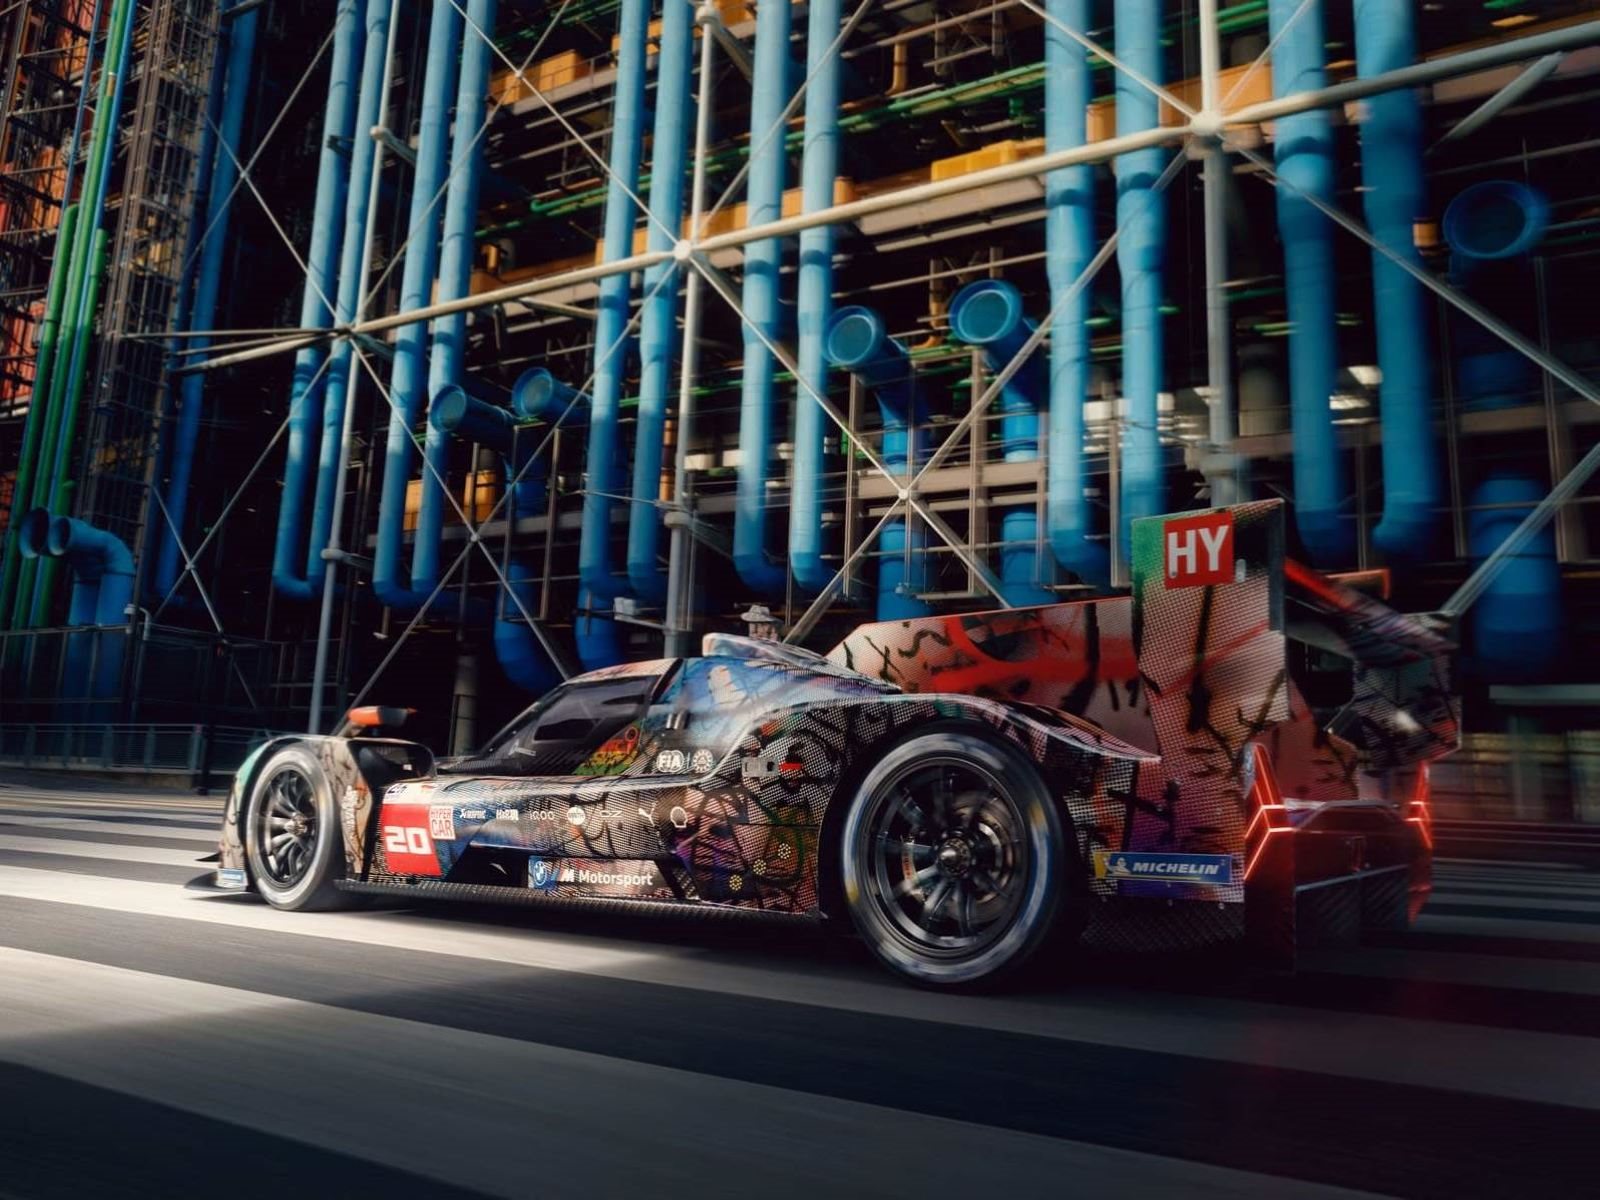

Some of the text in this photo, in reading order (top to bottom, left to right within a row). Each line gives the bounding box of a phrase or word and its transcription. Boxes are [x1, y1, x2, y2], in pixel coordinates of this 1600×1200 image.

[1168, 525, 1229, 578] HY
[659, 754, 681, 770] FIA
[431, 819, 453, 837] CAR
[384, 825, 432, 855] 20
[1133, 861, 1219, 875] MICHELIN
[579, 869, 653, 886] Motorsport
